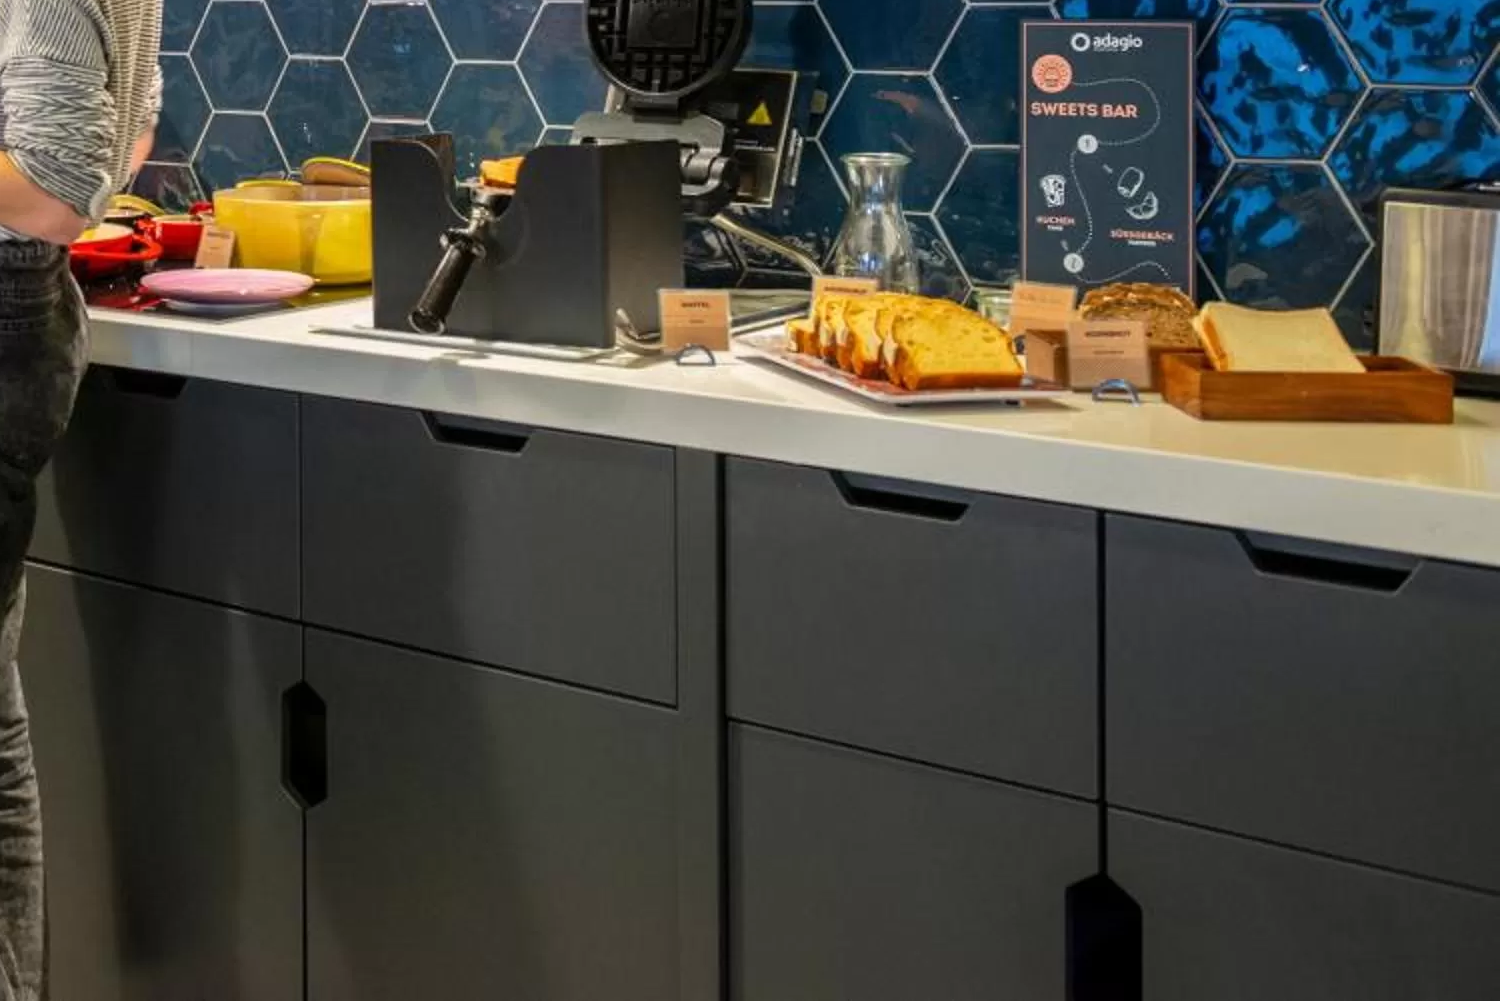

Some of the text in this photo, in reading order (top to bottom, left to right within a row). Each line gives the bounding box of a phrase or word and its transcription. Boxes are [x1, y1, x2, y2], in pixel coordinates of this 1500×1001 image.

[1093, 32, 1143, 52] adagio
[1031, 102, 1138, 119] SWEETS BAR
